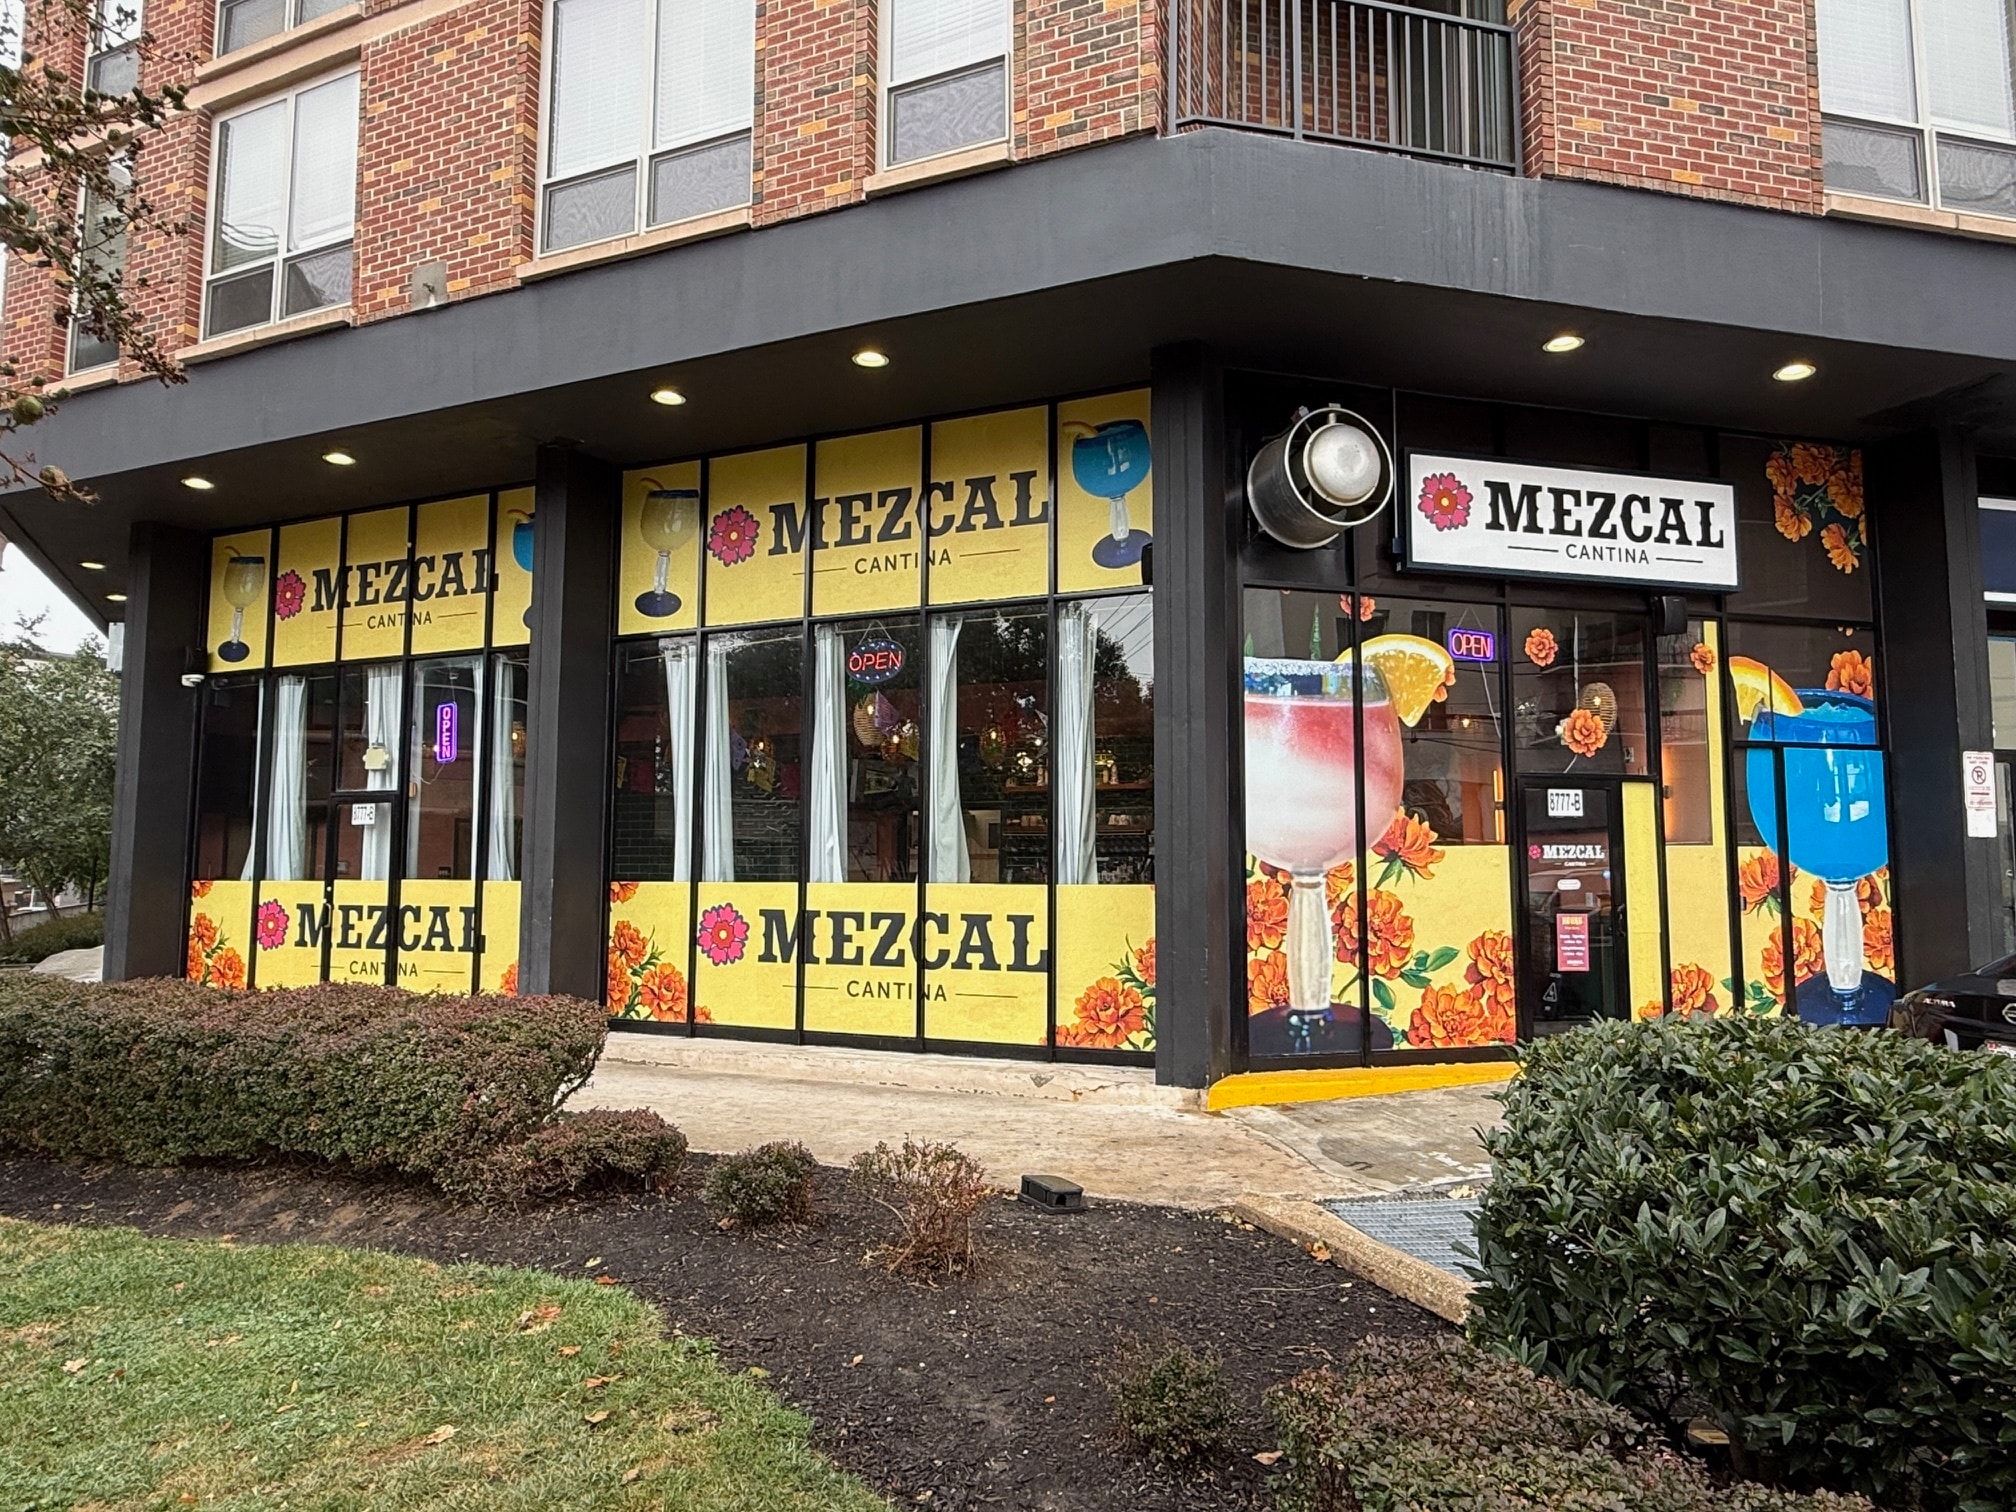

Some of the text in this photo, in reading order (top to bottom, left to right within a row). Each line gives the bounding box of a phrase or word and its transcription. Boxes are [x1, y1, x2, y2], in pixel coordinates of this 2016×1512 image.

[768, 470, 1048, 556] MEZCAL
[1484, 480, 1725, 548] MEZCAL
[1566, 544, 1650, 564] CANTINA
[310, 549, 499, 612] MEZCAL
[367, 610, 432, 629] CANTNA
[1452, 633, 1490, 658] OPEN
[849, 650, 902, 671] OPEN
[441, 707, 451, 758] OPEN
[1550, 793, 1581, 811] 8777-B
[1542, 844, 1605, 859] MEZCAL
[294, 903, 486, 954] MEZCAL
[758, 909, 1048, 972] MEZCAL
[349, 960, 418, 977] CANNA
